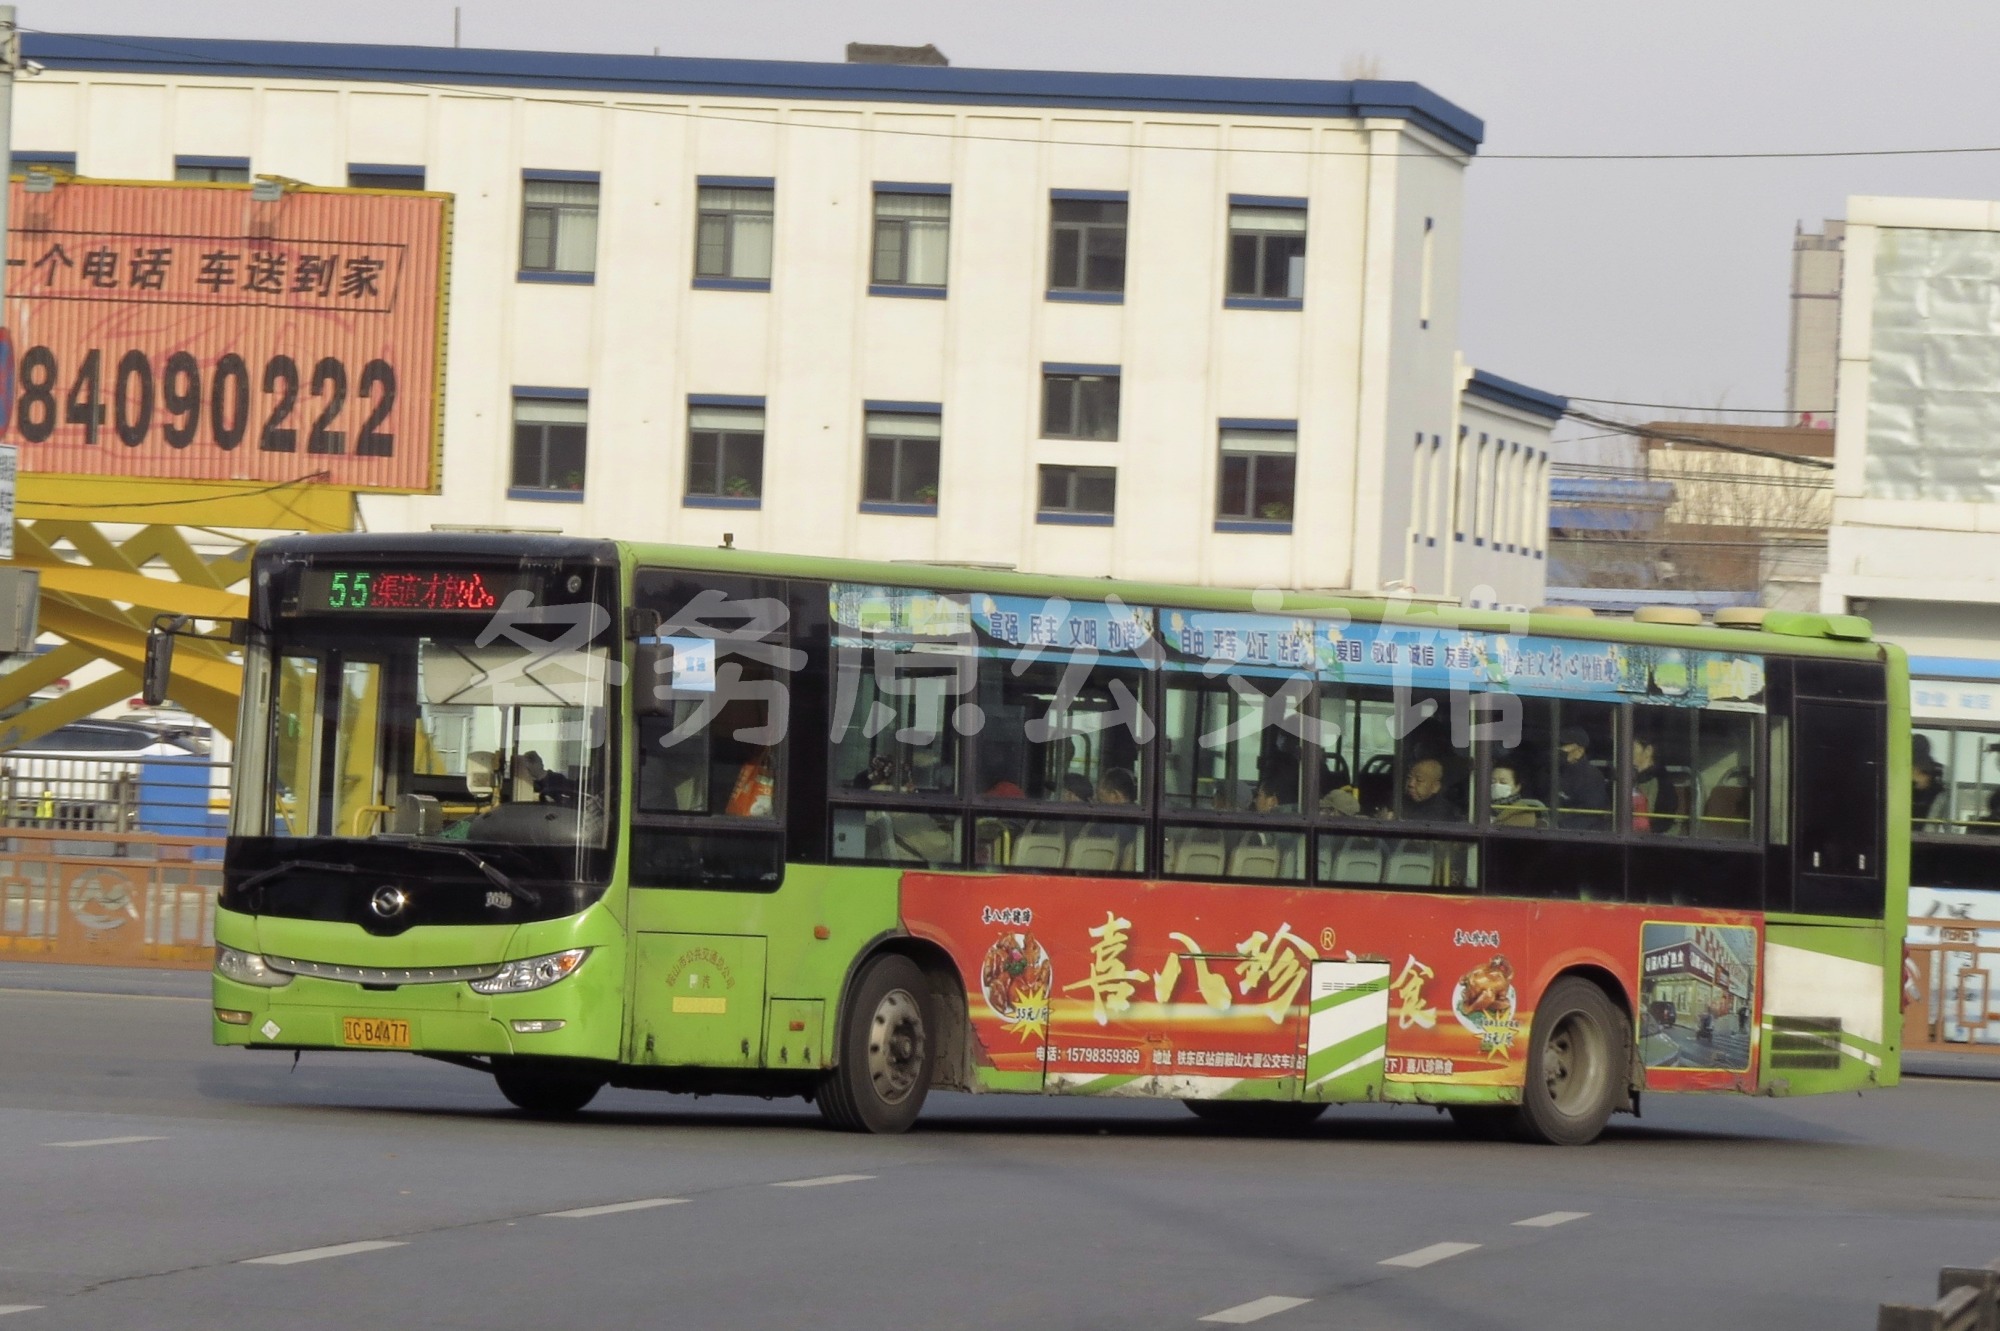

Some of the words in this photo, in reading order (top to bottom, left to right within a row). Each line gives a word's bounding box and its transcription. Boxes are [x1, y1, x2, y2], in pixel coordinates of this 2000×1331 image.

[196, 249, 384, 299] 车送到家
[17, 346, 397, 457] 84090222
[329, 572, 369, 608] 55
[990, 612, 1019, 645] 富强
[1030, 614, 1058, 645] 民主
[1069, 616, 1098, 648] 文明
[1108, 619, 1138, 650] 和谐
[1181, 627, 1204, 655] 自由
[1213, 629, 1236, 658] 平等
[1245, 631, 1269, 660] 公正
[1277, 632, 1300, 662] 法治
[1336, 640, 1362, 663] 爱国
[1371, 641, 1399, 664] 敬业
[1408, 643, 1434, 667] 诚信
[1444, 645, 1470, 669] 友善
[1062, 911, 1320, 1027] 喜八珍
